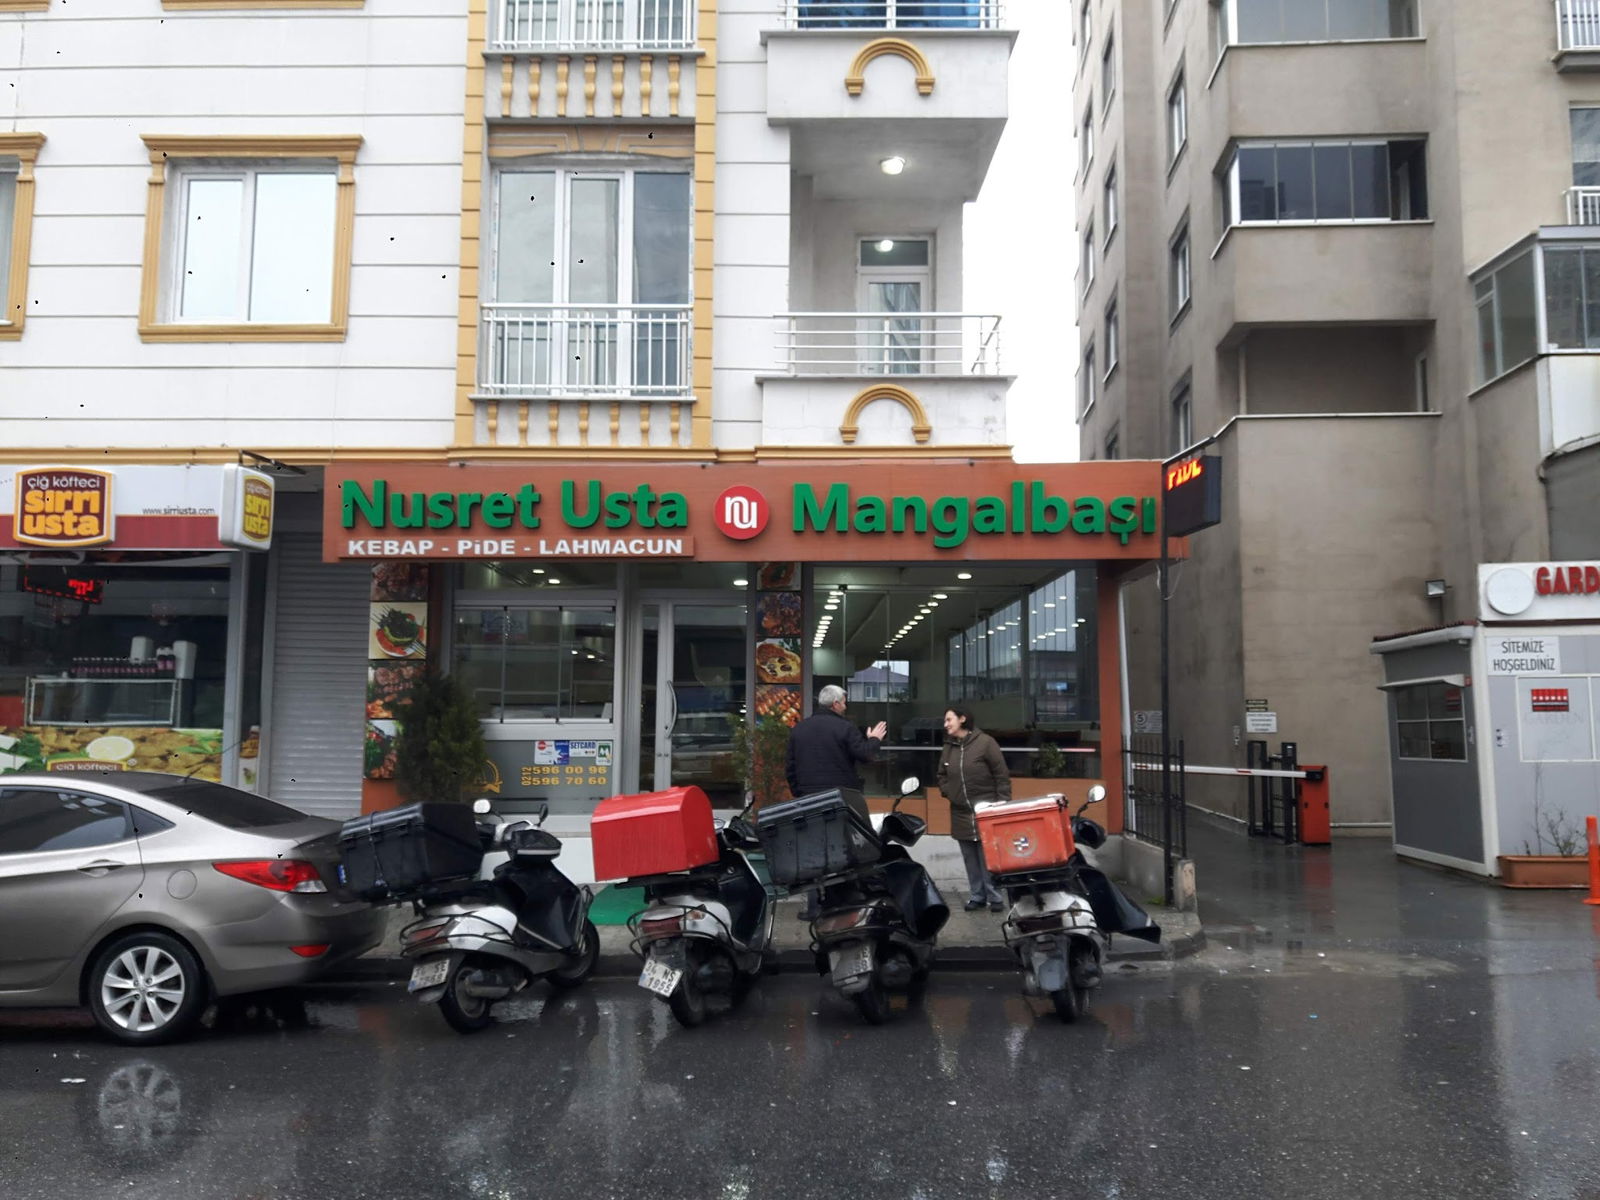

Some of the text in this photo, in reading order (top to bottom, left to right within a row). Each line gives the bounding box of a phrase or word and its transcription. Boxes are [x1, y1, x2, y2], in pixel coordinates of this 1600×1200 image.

[27, 476, 100, 490] çiğ köfteci
[341, 480, 688, 530] Nusret Usta
[793, 480, 1156, 548] Mangalbaşı
[23, 510, 100, 536] usta
[348, 540, 434, 555] KEBAP
[540, 539, 683, 555] LAHMACUN
[1502, 638, 1544, 653] SİTEMİZE
[1493, 656, 1555, 672] HOŞGELDİNİZ
[533, 766, 560, 775] 596
[565, 766, 584, 775] 00
[532, 776, 560, 786] 596
[565, 776, 584, 786] 70
